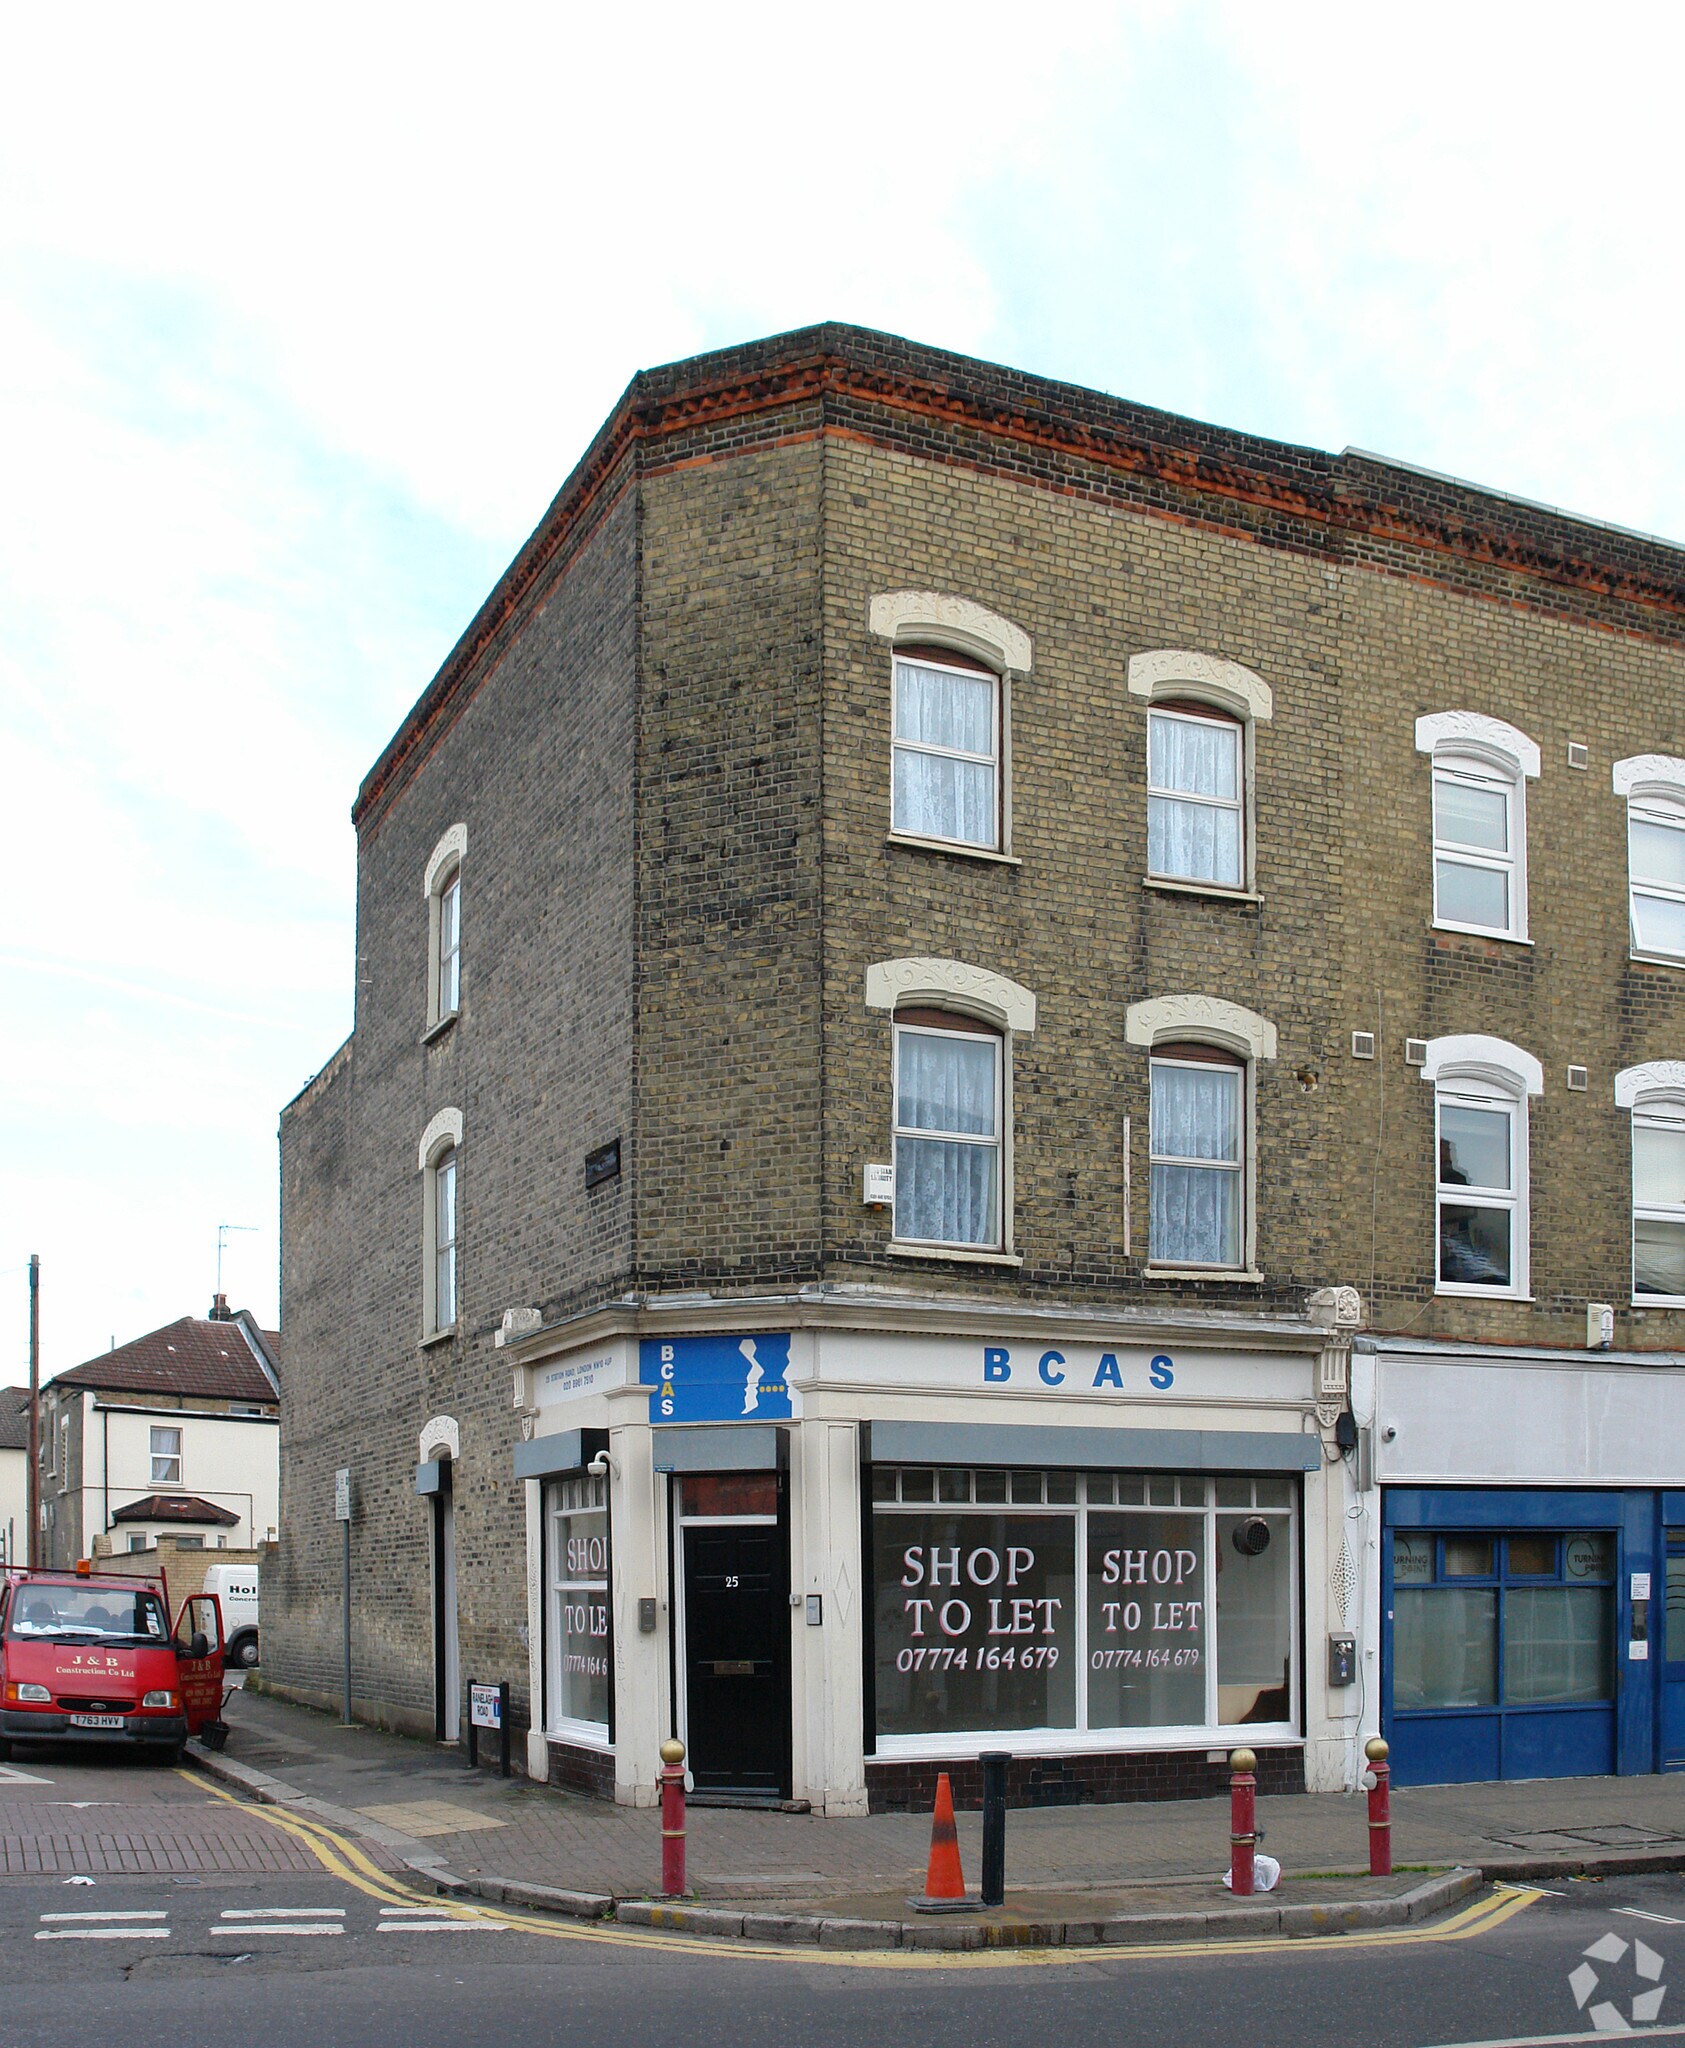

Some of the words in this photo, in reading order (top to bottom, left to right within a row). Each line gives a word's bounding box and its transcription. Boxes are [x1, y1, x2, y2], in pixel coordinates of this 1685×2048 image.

[661, 1345, 675, 1415] BCAS
[984, 1347, 1175, 1390] BCAS
[901, 1546, 1035, 1588] SHOP
[1102, 1549, 1197, 1585] SHOP
[725, 1575, 739, 1588] 25
[564, 1605, 586, 1635] TO
[904, 1598, 972, 1637] TO
[988, 1598, 1062, 1636] LET
[1102, 1601, 1141, 1632] TO
[1152, 1601, 1202, 1631] LET
[72, 1656, 82, 1665] J
[87, 1656, 100, 1665] &
[106, 1657, 118, 1667] B
[192, 1661, 196, 1671] J
[206, 1660, 211, 1670] B
[896, 1648, 968, 1673] 07774
[976, 1647, 1015, 1671] 164
[1020, 1647, 1060, 1671] 679
[1091, 1649, 1142, 1669] 07774
[1145, 1649, 1170, 1667] 164
[1173, 1648, 1199, 1666] 679
[56, 1666, 106, 1675] Construction
[108, 1668, 119, 1676] Co
[121, 1669, 135, 1677] Ltd
[472, 1692, 493, 1705] RANELAGH
[75, 1716, 99, 1726] T763
[477, 1704, 488, 1717] ROAD
